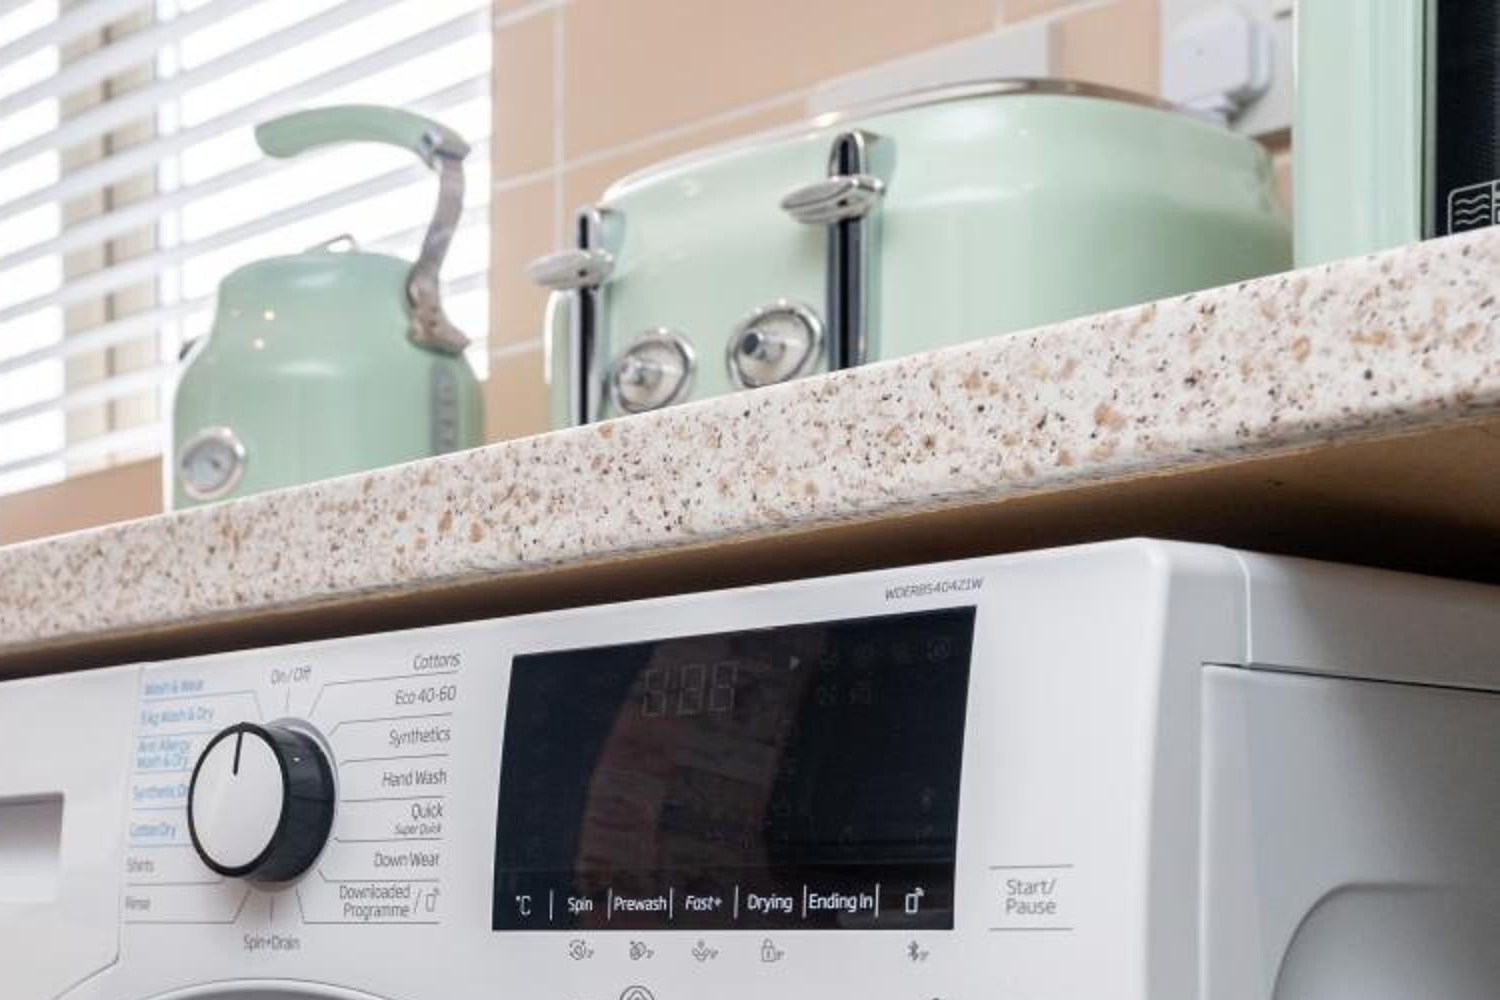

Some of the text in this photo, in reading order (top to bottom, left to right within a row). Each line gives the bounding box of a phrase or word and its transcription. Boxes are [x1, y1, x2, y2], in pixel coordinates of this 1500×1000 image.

[413, 653, 460, 671] Cottons
[395, 685, 457, 706] Eco 40-60
[388, 728, 451, 748] Synthetics
[381, 769, 448, 787] Hand Wash
[411, 802, 444, 820] Quick
[373, 851, 440, 868] Down Wear
[339, 884, 411, 900] Downloaded
[1006, 878, 1057, 896] Start/
[343, 902, 410, 921] Programme
[567, 896, 593, 915] Spin
[613, 896, 667, 912] Prewash
[685, 895, 723, 912] Fast+
[747, 892, 793, 914] Drying
[809, 892, 873, 913] Ending In
[1006, 898, 1057, 916] Pause
